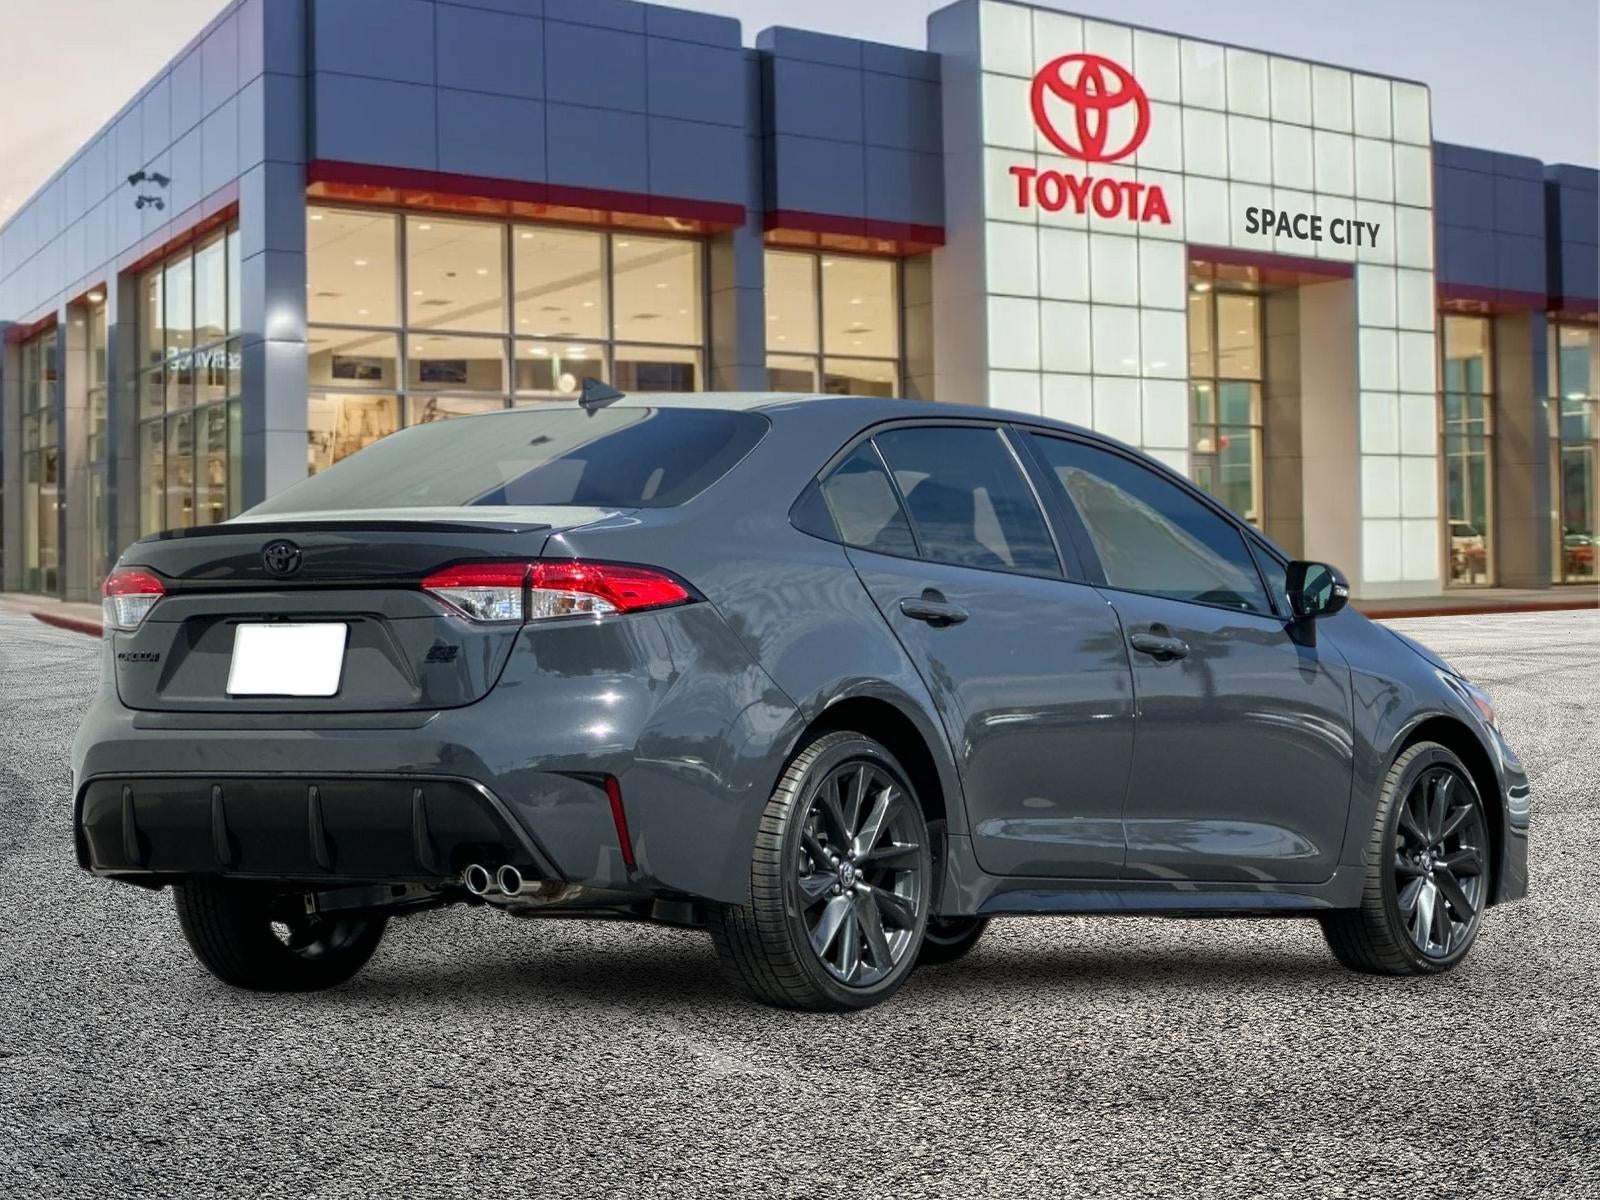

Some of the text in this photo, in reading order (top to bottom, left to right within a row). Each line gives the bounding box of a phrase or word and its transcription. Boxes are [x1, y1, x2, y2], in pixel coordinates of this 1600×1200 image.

[1009, 166, 1170, 224] TOYOTA
[1245, 206, 1381, 248] SPACE CITY
